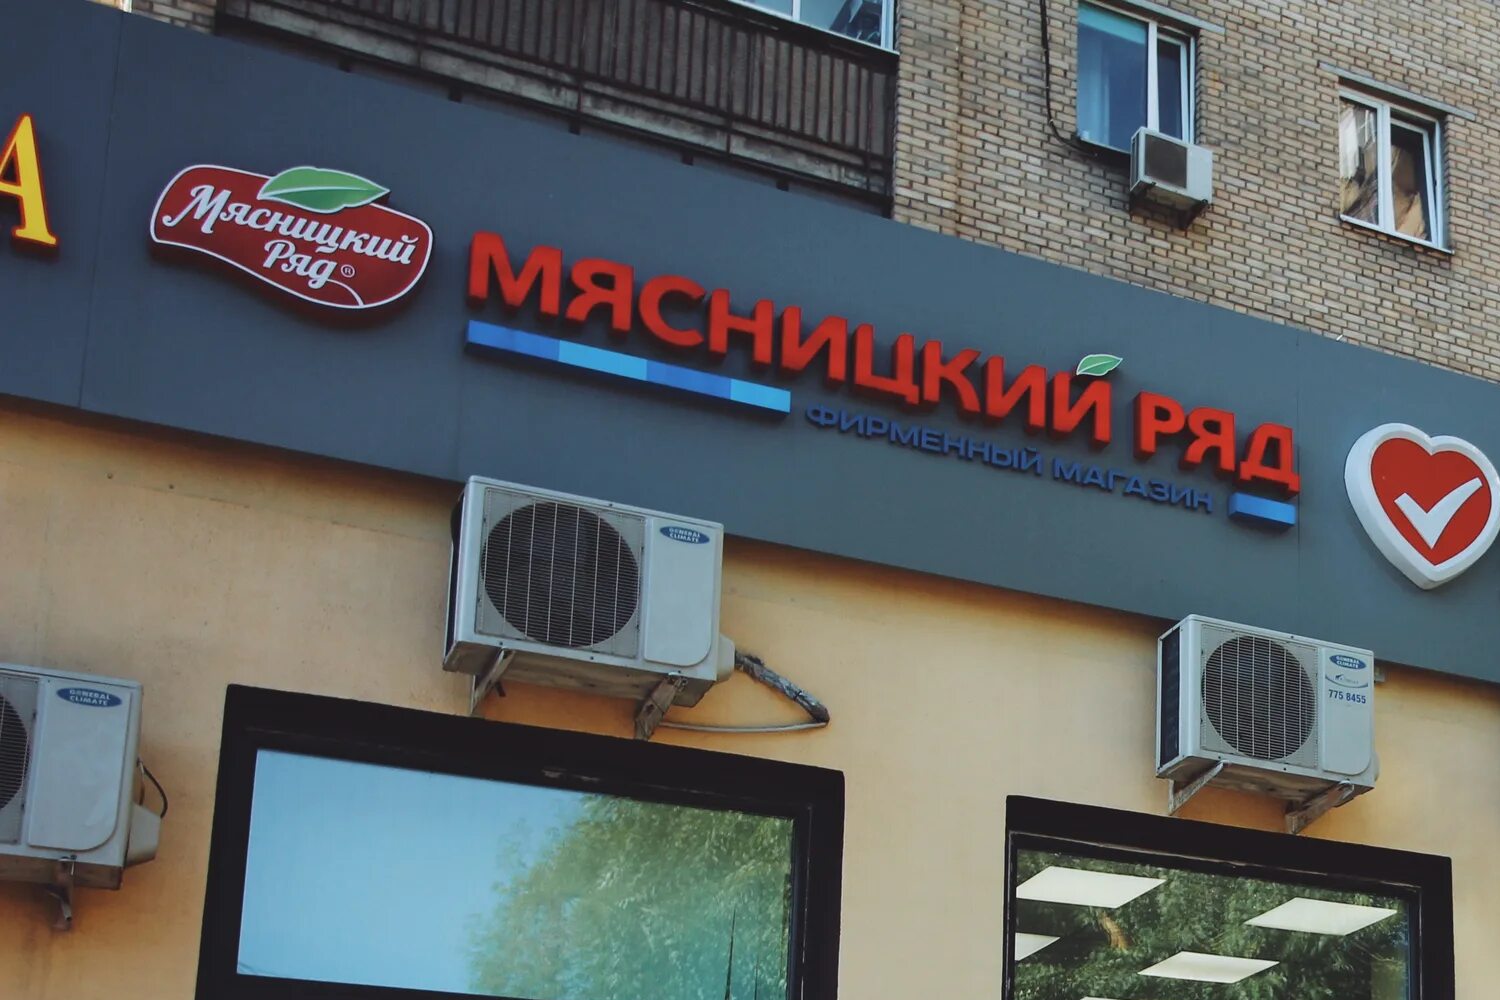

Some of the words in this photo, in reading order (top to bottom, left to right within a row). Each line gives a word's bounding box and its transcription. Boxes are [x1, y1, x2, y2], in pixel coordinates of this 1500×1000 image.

[162, 185, 419, 265] Мясницкий
[263, 240, 337, 289] Ряд
[468, 231, 1111, 446] МЯСНИЦКИЙ
[1133, 391, 1300, 496] РЯД
[805, 402, 1044, 477] ФИРМЕННЫЙ
[1052, 456, 1214, 513] МАГАЗИН
[669, 527, 701, 538] GENERAL
[669, 533, 699, 543] CLIMATE
[69, 689, 111, 701] GENERAL
[69, 695, 109, 706] CLIMATE
[1328, 689, 1344, 700] 775
[1346, 692, 1366, 704] 8455
